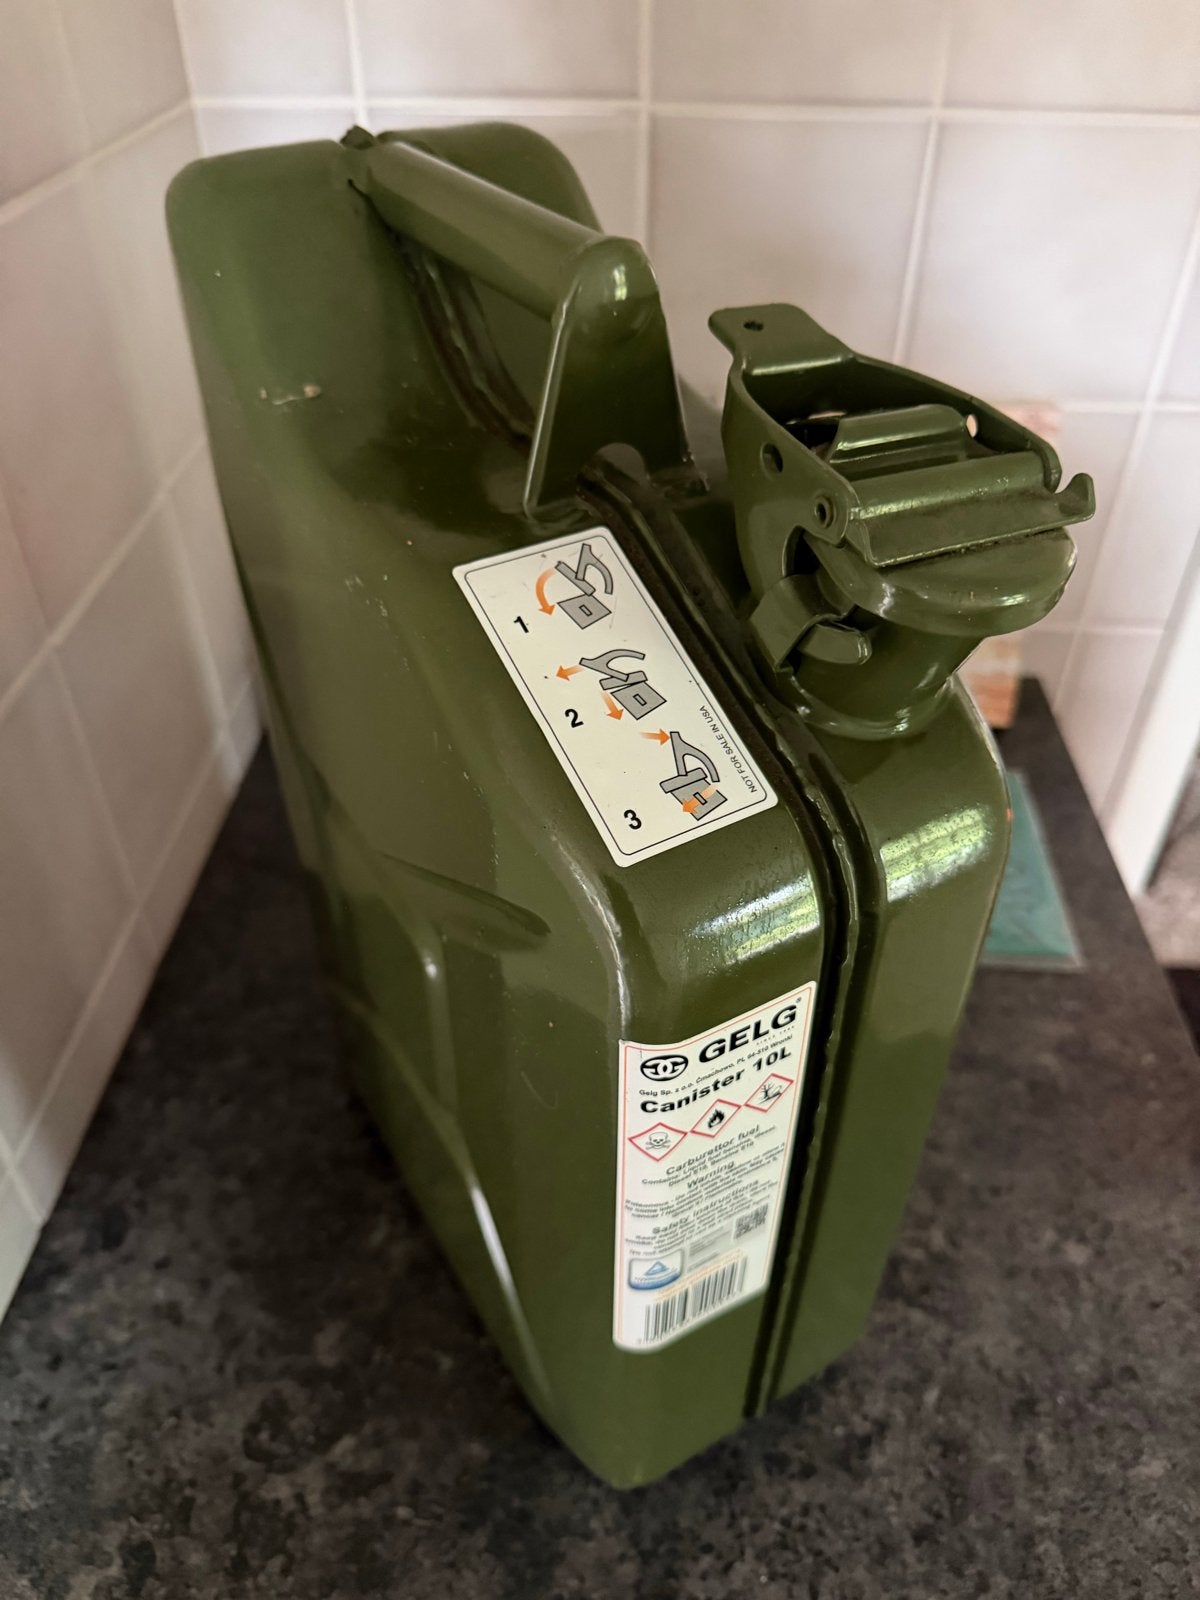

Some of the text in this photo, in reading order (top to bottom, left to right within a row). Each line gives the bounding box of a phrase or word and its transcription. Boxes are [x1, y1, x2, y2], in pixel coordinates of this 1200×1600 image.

[513, 616, 529, 633] 1
[564, 708, 584, 728] 2
[699, 705, 757, 793] NOT FOR SALE IN USA
[623, 809, 642, 830] 3
[698, 1004, 797, 1063] GELG
[640, 1046, 792, 1113] Canister 10L
[665, 1137, 735, 1175] Carburettor
[738, 1124, 760, 1141] fuel
[687, 1161, 735, 1188] Warning
